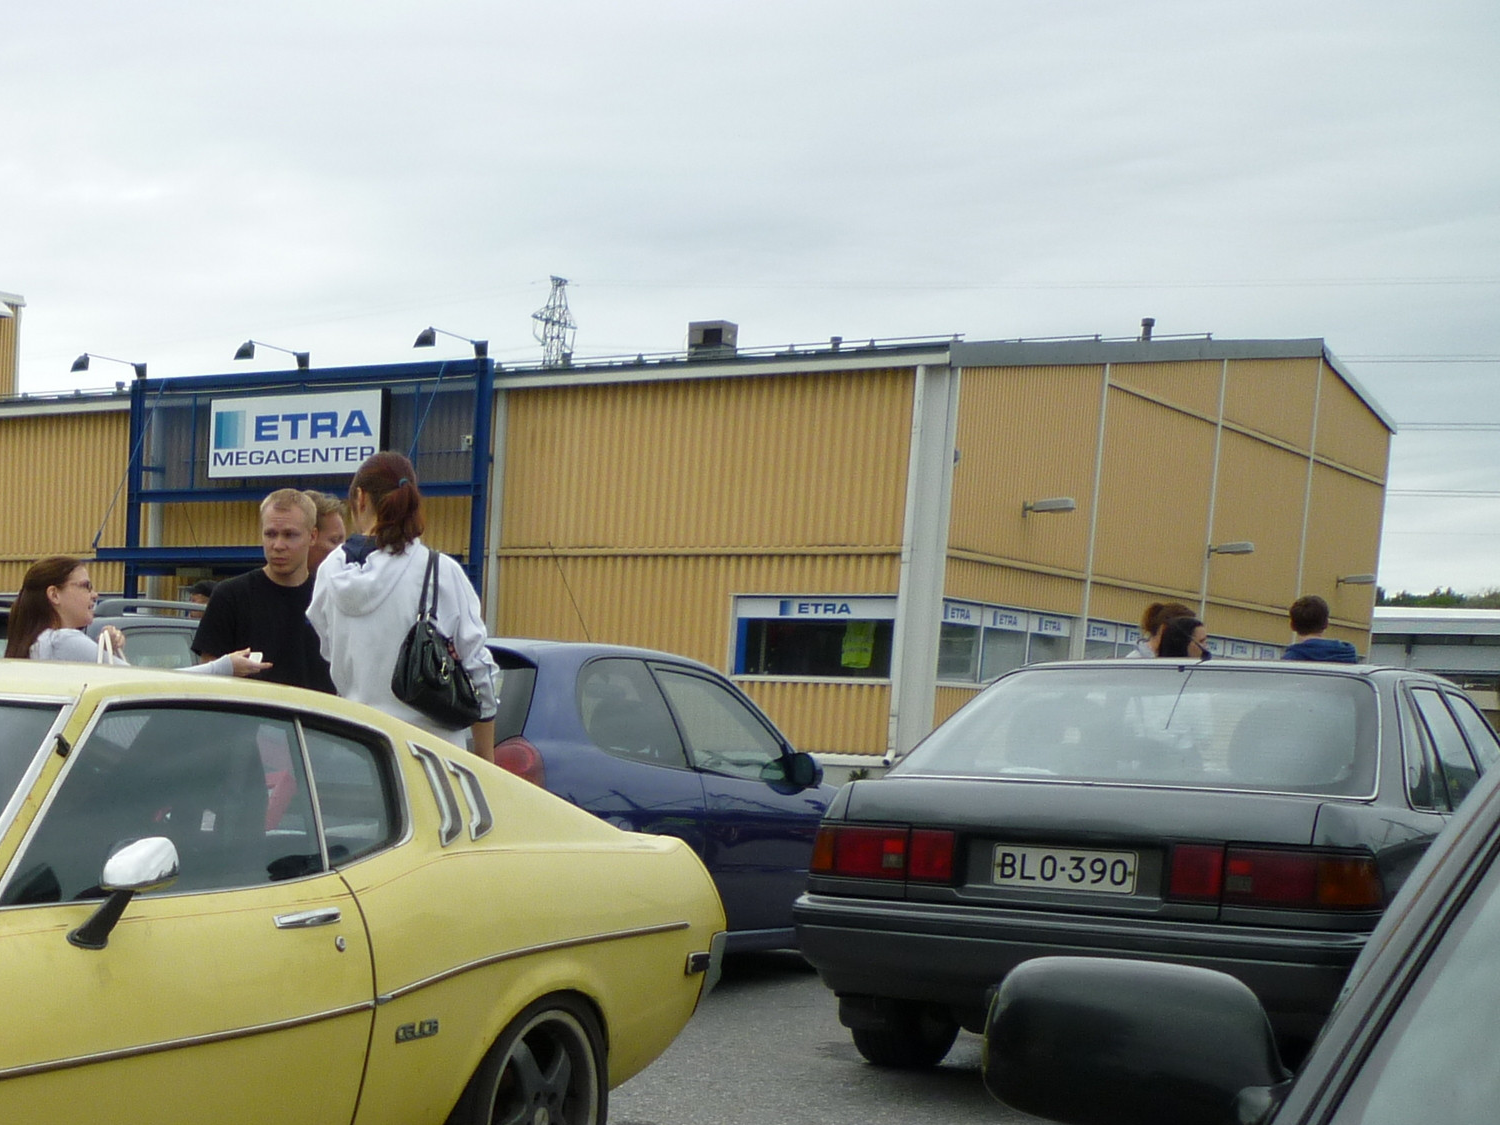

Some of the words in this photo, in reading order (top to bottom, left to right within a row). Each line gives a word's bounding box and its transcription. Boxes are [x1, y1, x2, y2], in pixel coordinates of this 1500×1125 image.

[254, 410, 373, 442] ETRA
[213, 446, 376, 466] MEGACENTER
[797, 603, 852, 615] ETRA
[950, 606, 971, 620] ETRA
[999, 613, 1018, 627] ETRA
[1043, 619, 1062, 633] ETRA
[1091, 626, 1108, 638] ETRA
[999, 852, 1128, 887] BLO-390
